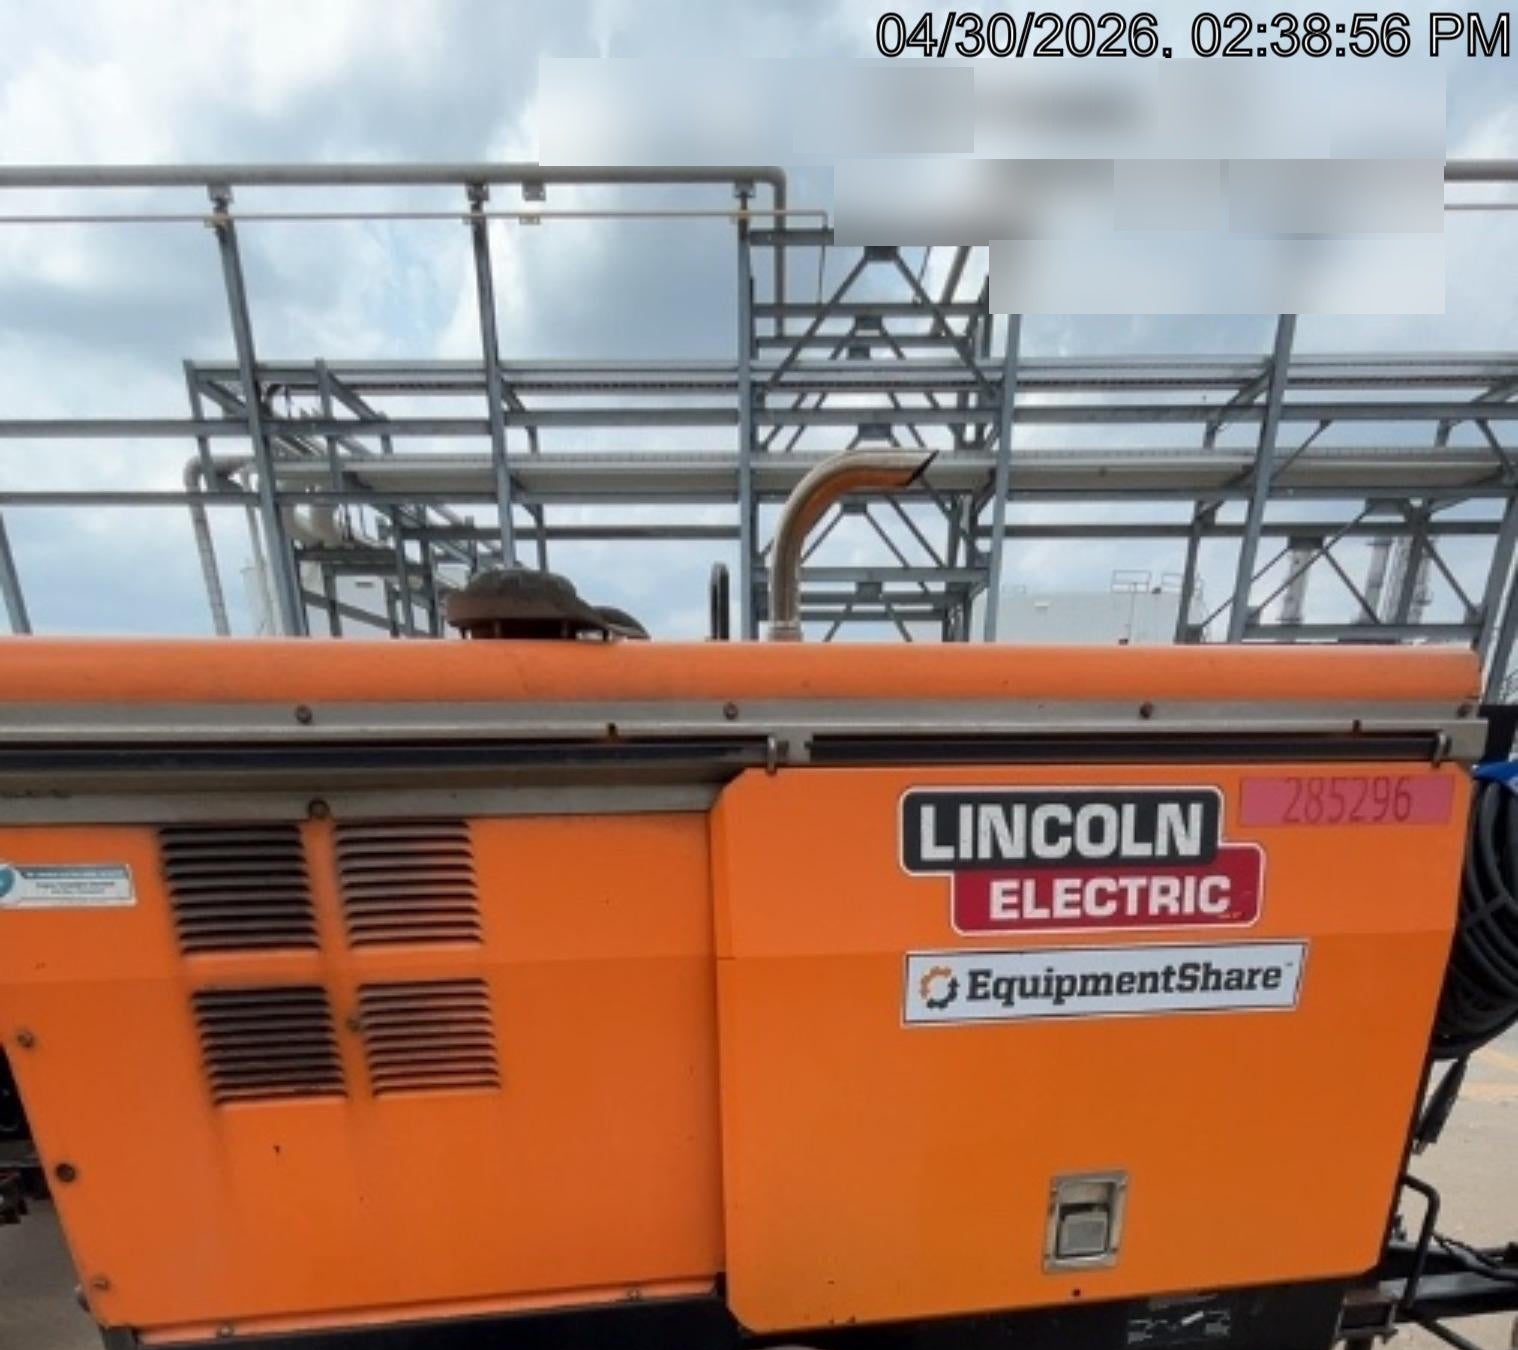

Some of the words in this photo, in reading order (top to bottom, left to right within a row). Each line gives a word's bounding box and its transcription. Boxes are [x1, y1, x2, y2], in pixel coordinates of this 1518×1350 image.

[1283, 776, 1411, 823] 285296
[920, 801, 1204, 861] LINCOLN
[989, 876, 1231, 920] ELECTRIC
[966, 962, 1282, 1006] EquipmentShare
